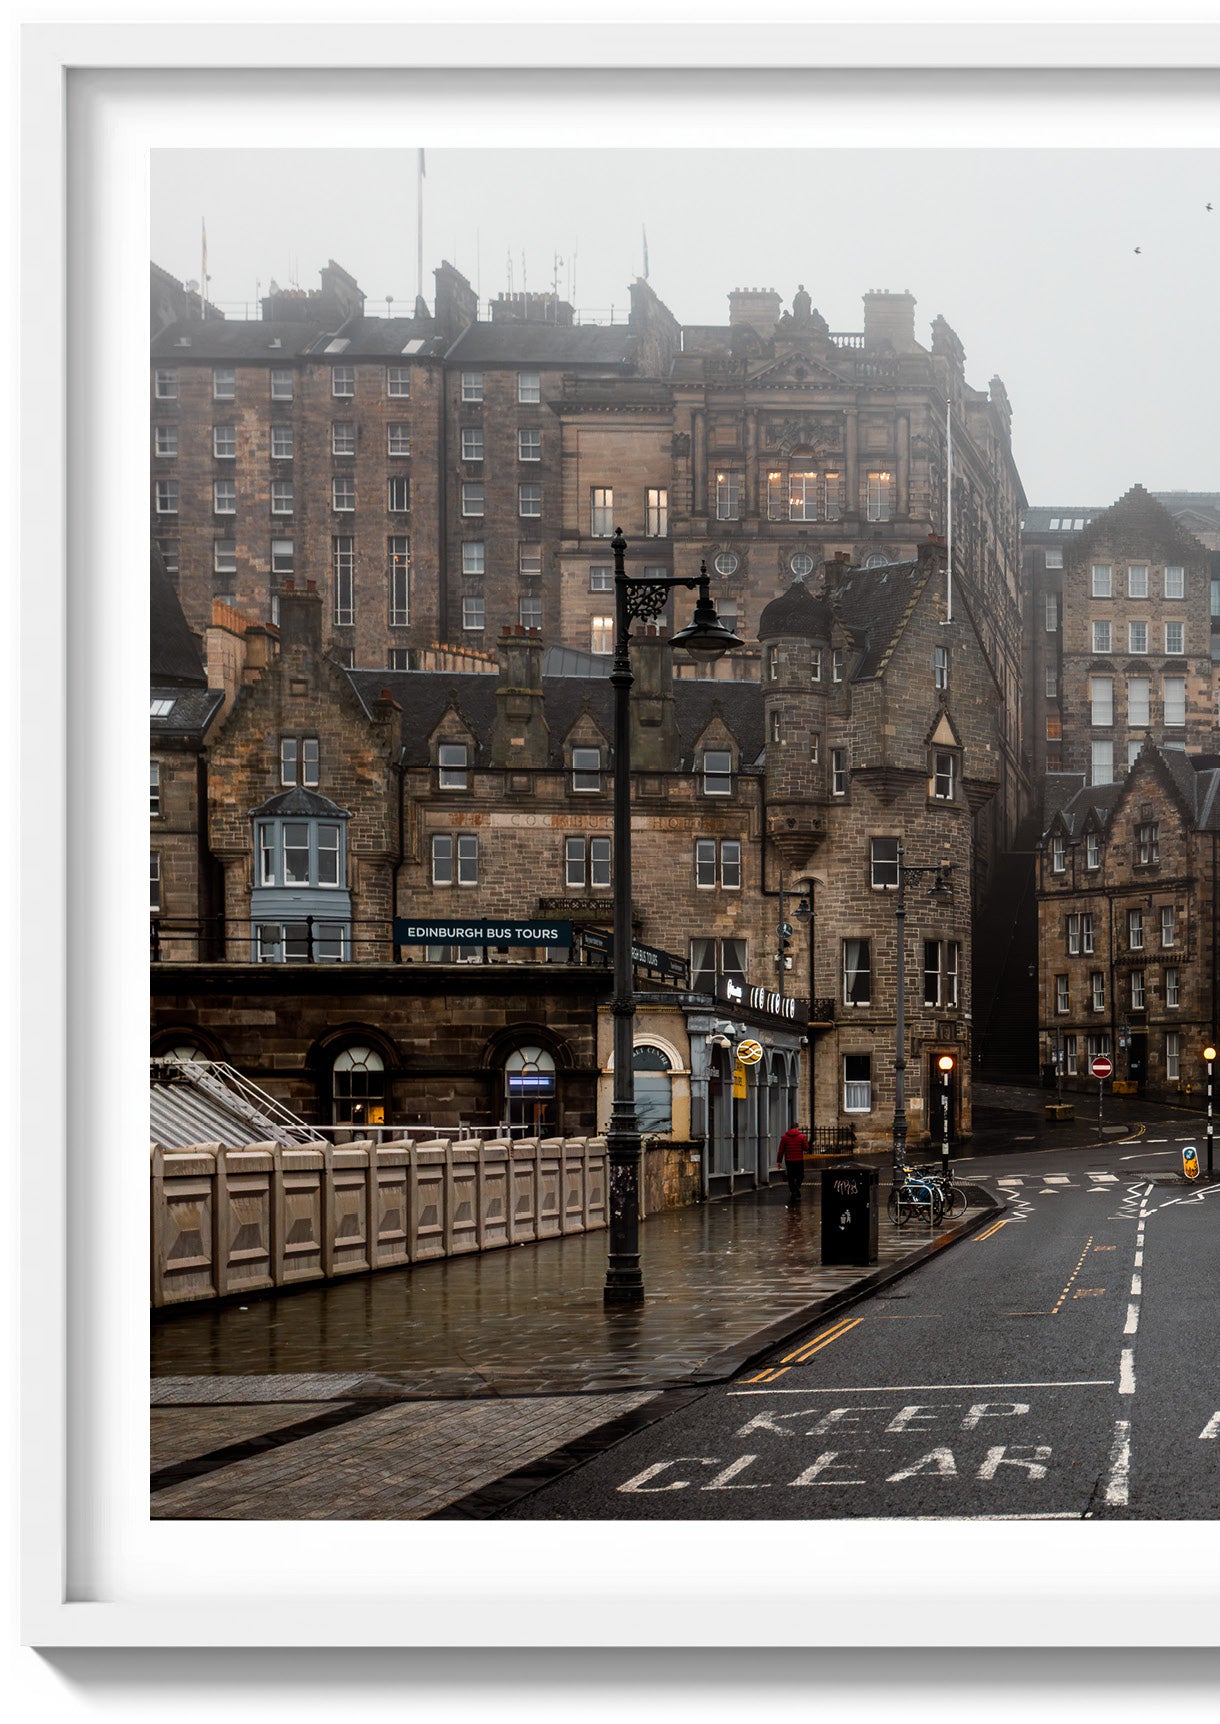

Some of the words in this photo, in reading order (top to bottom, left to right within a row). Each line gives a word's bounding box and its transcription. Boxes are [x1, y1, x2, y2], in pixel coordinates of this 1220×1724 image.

[511, 813, 615, 829] COCKBUR
[407, 927, 483, 938] EDINBURGH
[487, 928, 512, 939] BUS
[515, 928, 558, 939] TOURS
[734, 1403, 1030, 1438] KEEP
[616, 1445, 1053, 1493] CLEAR
